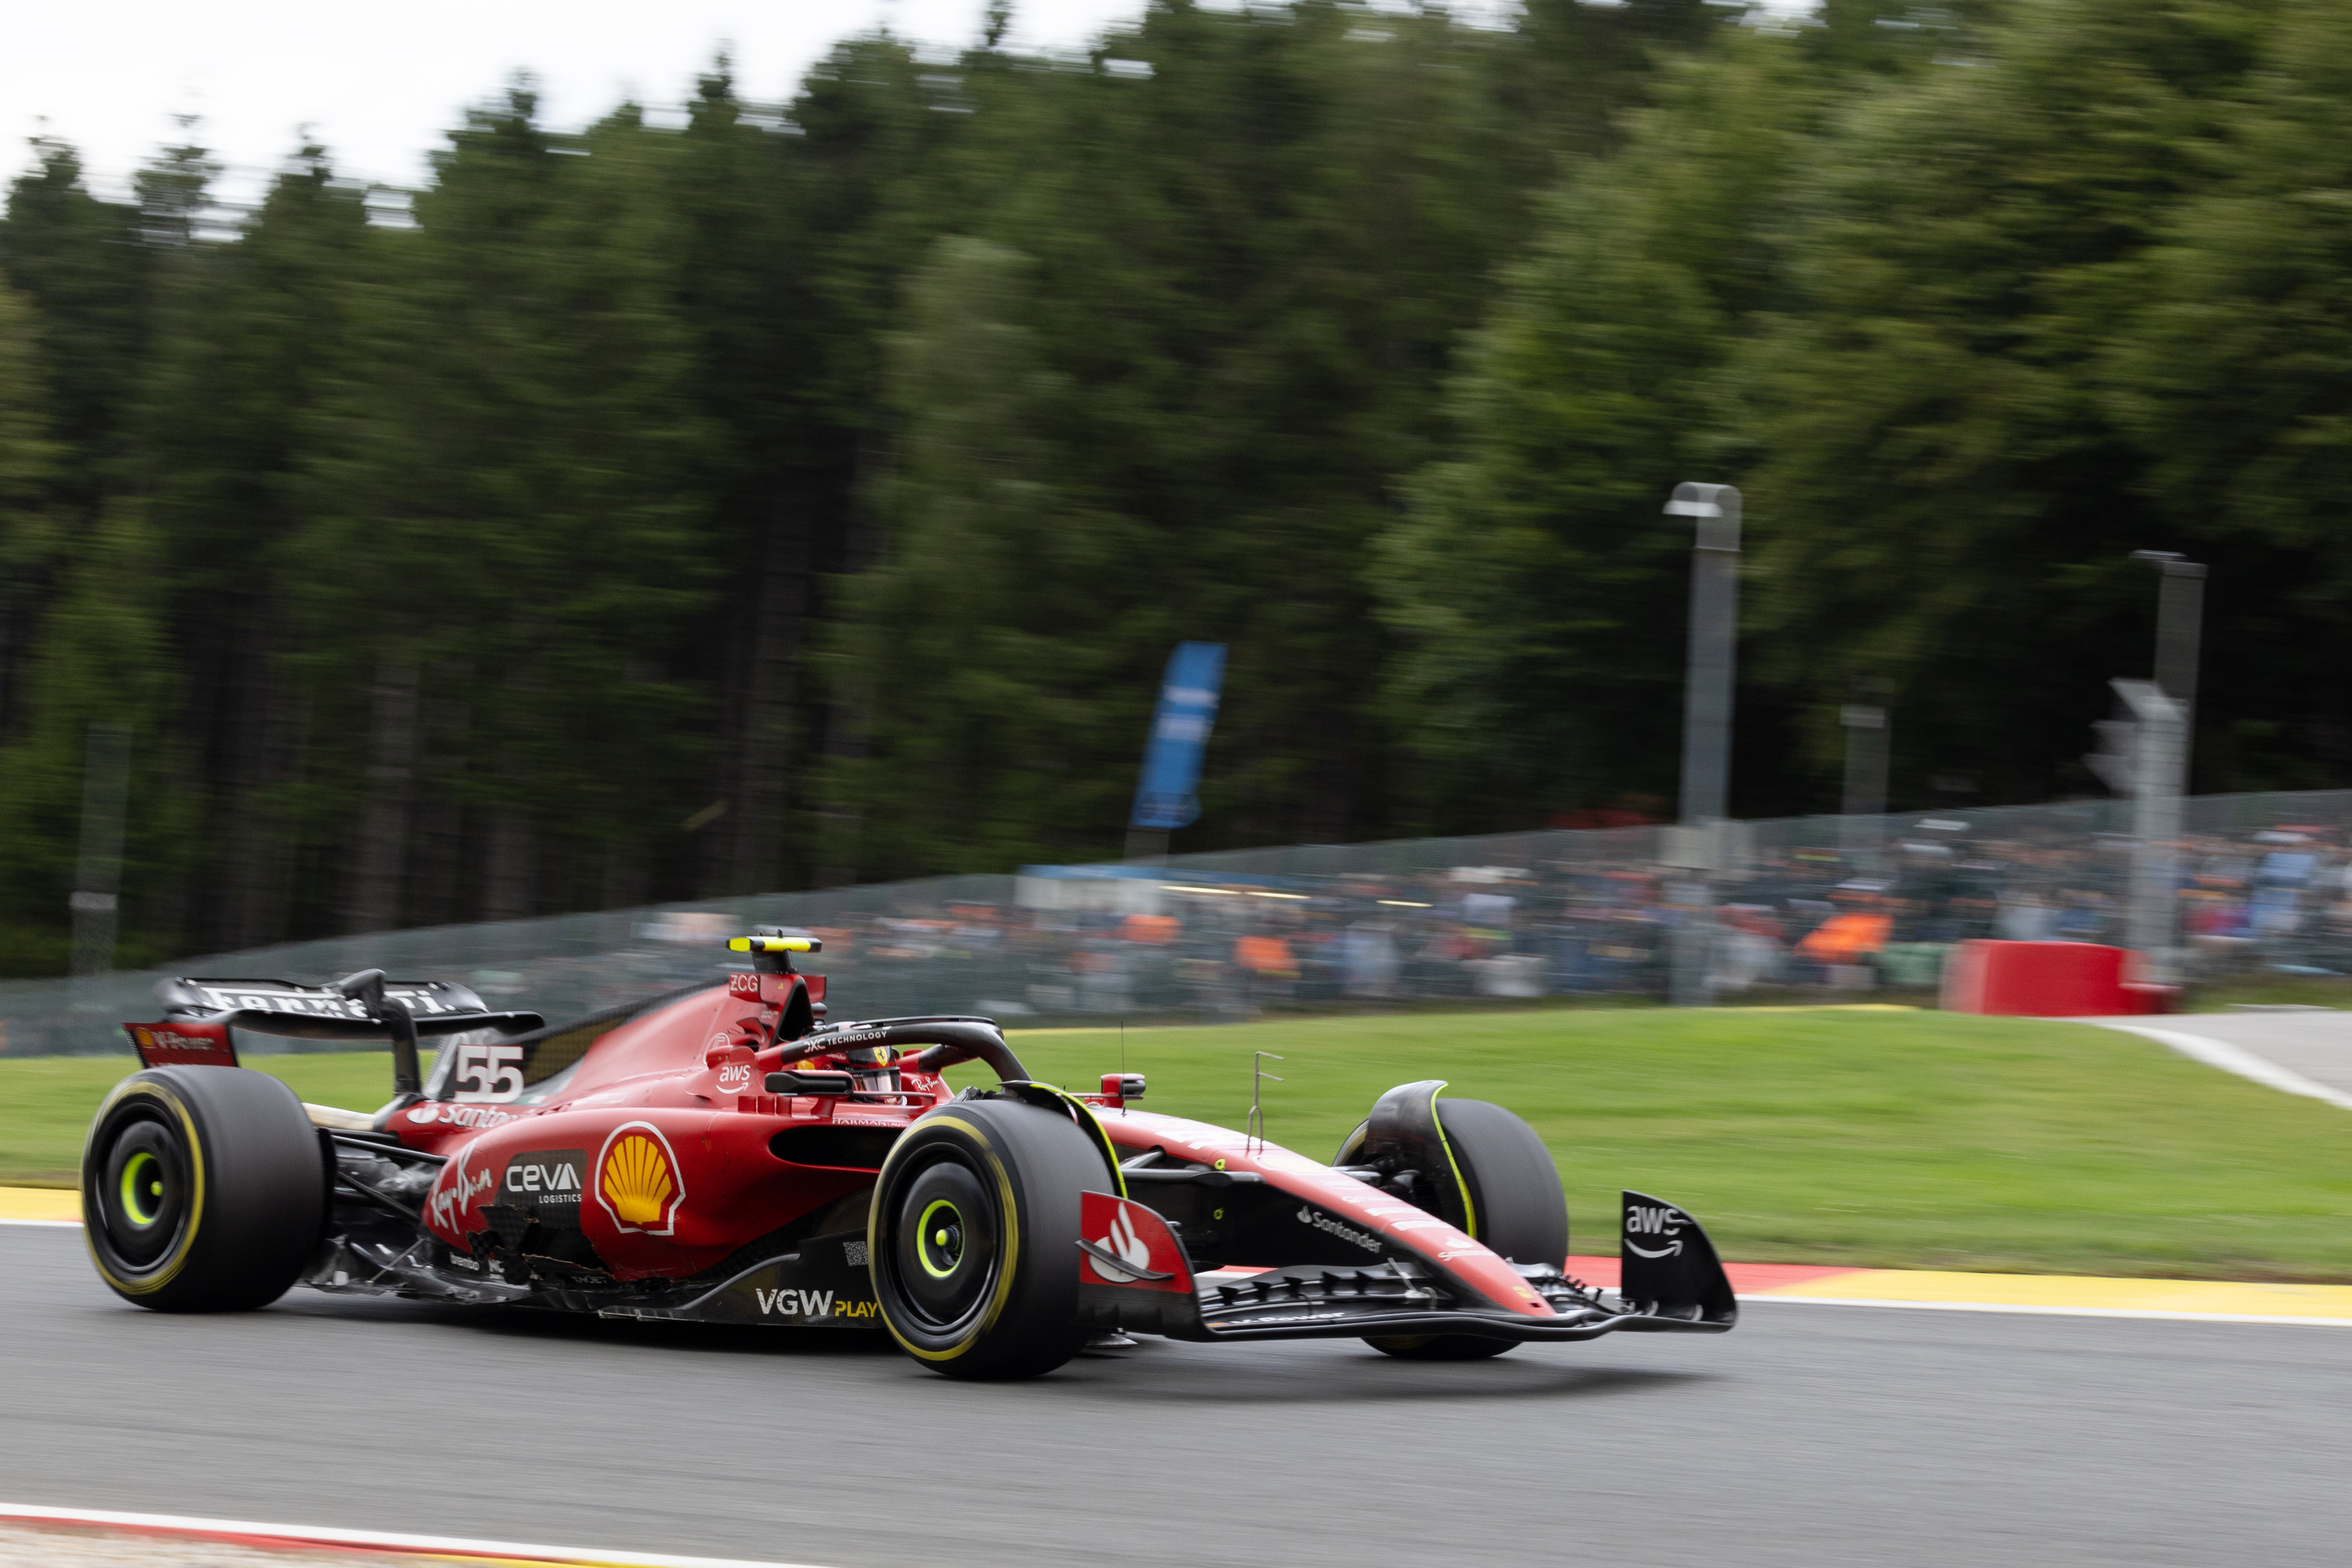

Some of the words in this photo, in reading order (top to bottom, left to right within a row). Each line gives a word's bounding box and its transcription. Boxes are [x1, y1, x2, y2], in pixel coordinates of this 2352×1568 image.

[730, 974, 758, 992] ZCG
[804, 1037, 826, 1053] DXC
[827, 1031, 887, 1045] TECHNOLOGY
[451, 1044, 525, 1103] 55
[720, 1065, 750, 1082] aws
[832, 1118, 886, 1126] HARMAN
[539, 1194, 582, 1204] LOGISTICS
[1626, 1206, 1680, 1235] aws
[1312, 1211, 1383, 1253] Santander
[449, 1252, 480, 1271] brembo
[756, 1288, 833, 1316] VGW
[835, 1300, 878, 1317] PLAY
